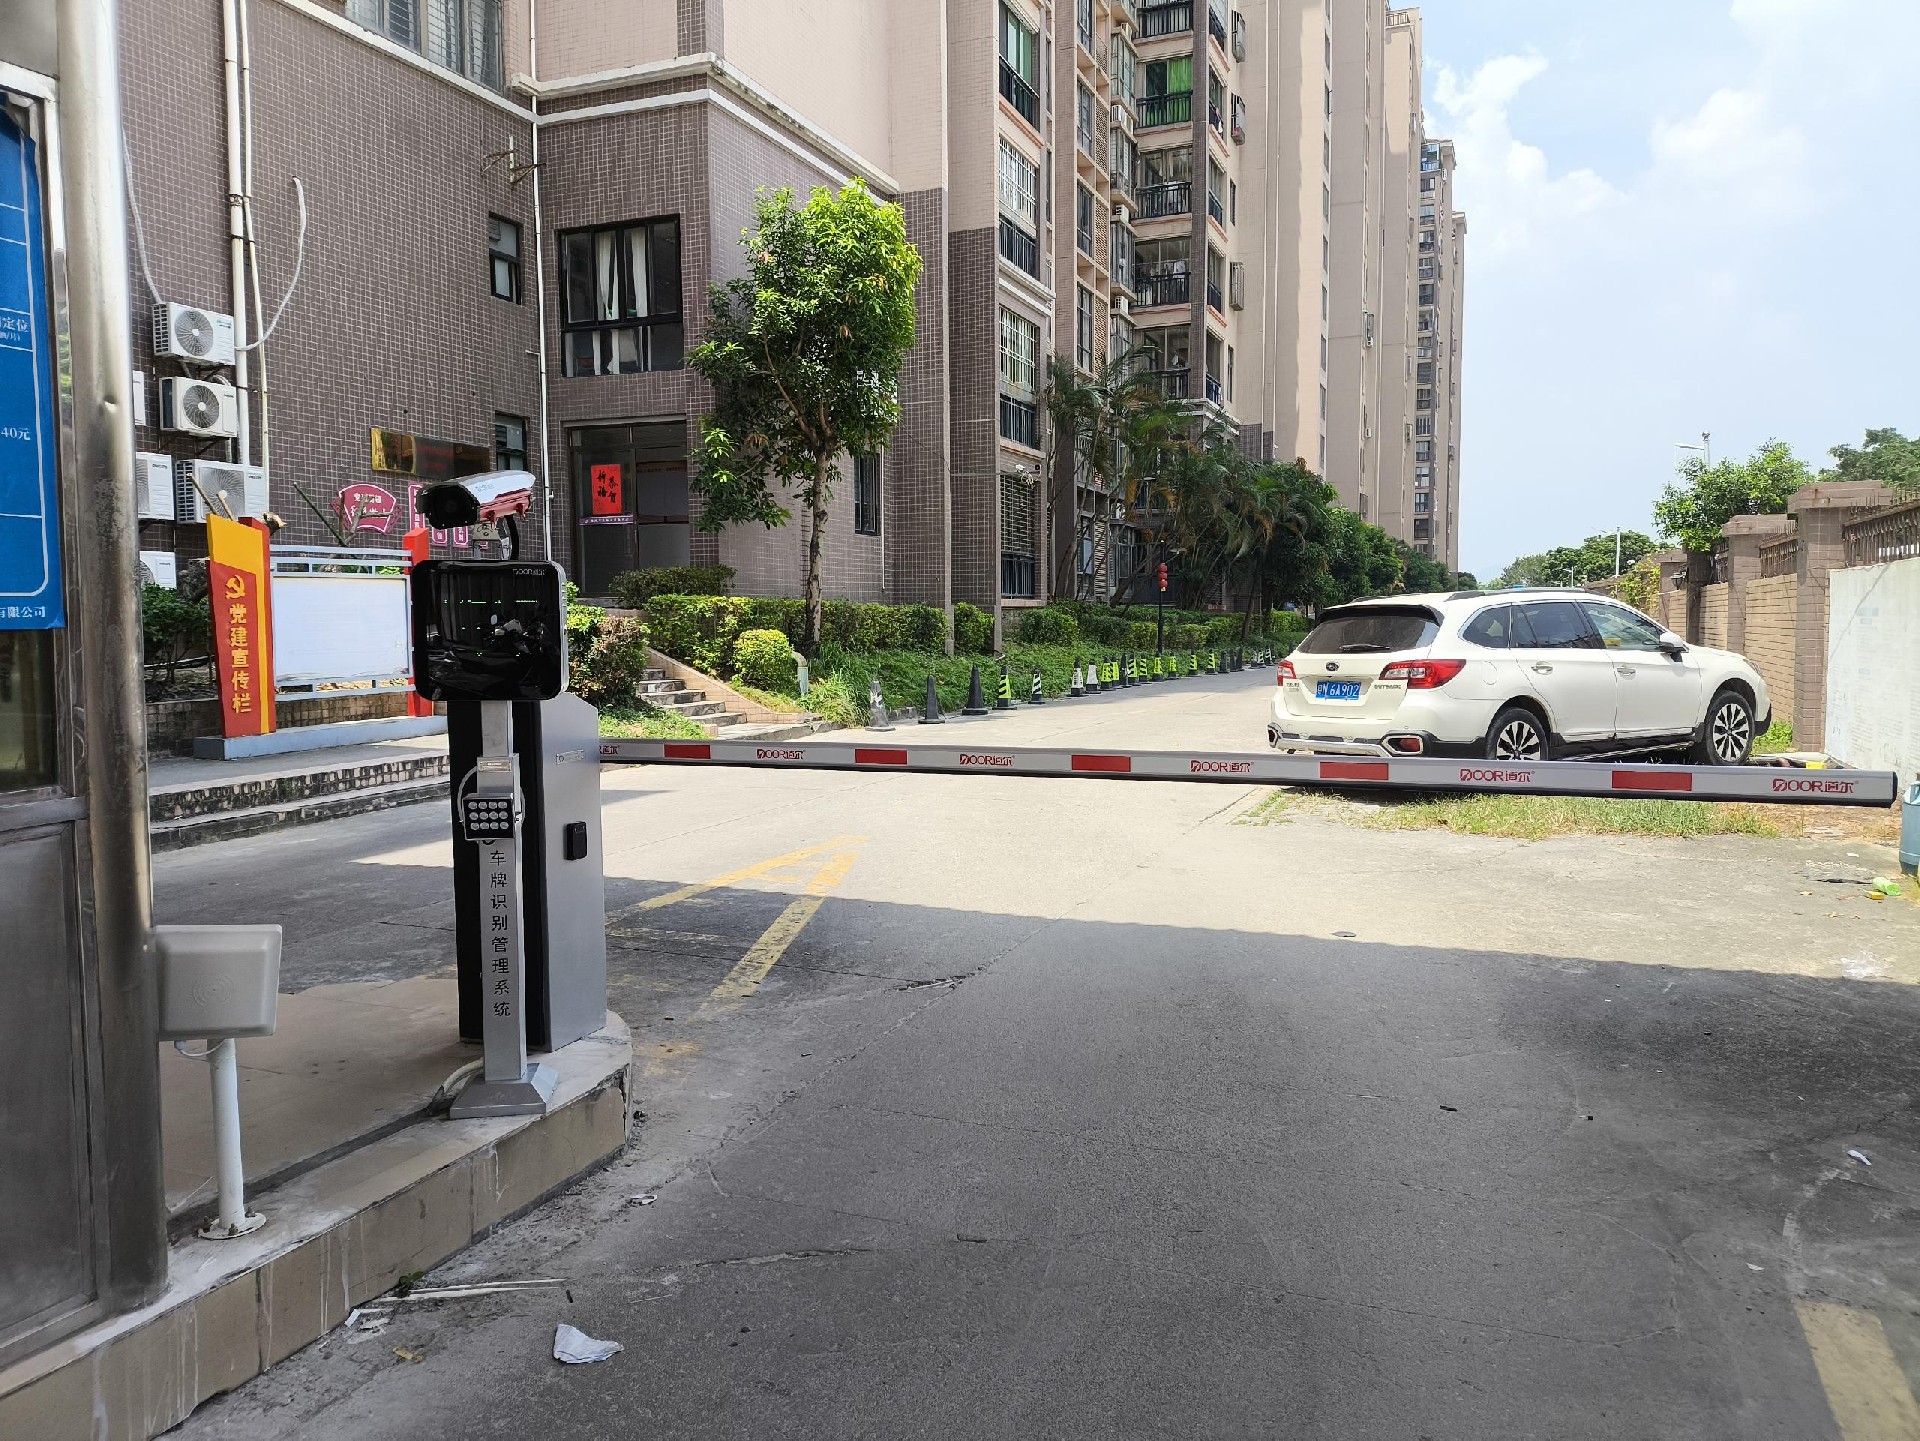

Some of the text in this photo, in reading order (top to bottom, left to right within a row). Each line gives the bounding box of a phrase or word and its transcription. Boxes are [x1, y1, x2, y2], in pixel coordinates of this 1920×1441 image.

[0, 317, 29, 332] 定位
[229, 603, 252, 713] 党建宣传栏
[489, 850, 511, 1017] 车牌识别管理系统
